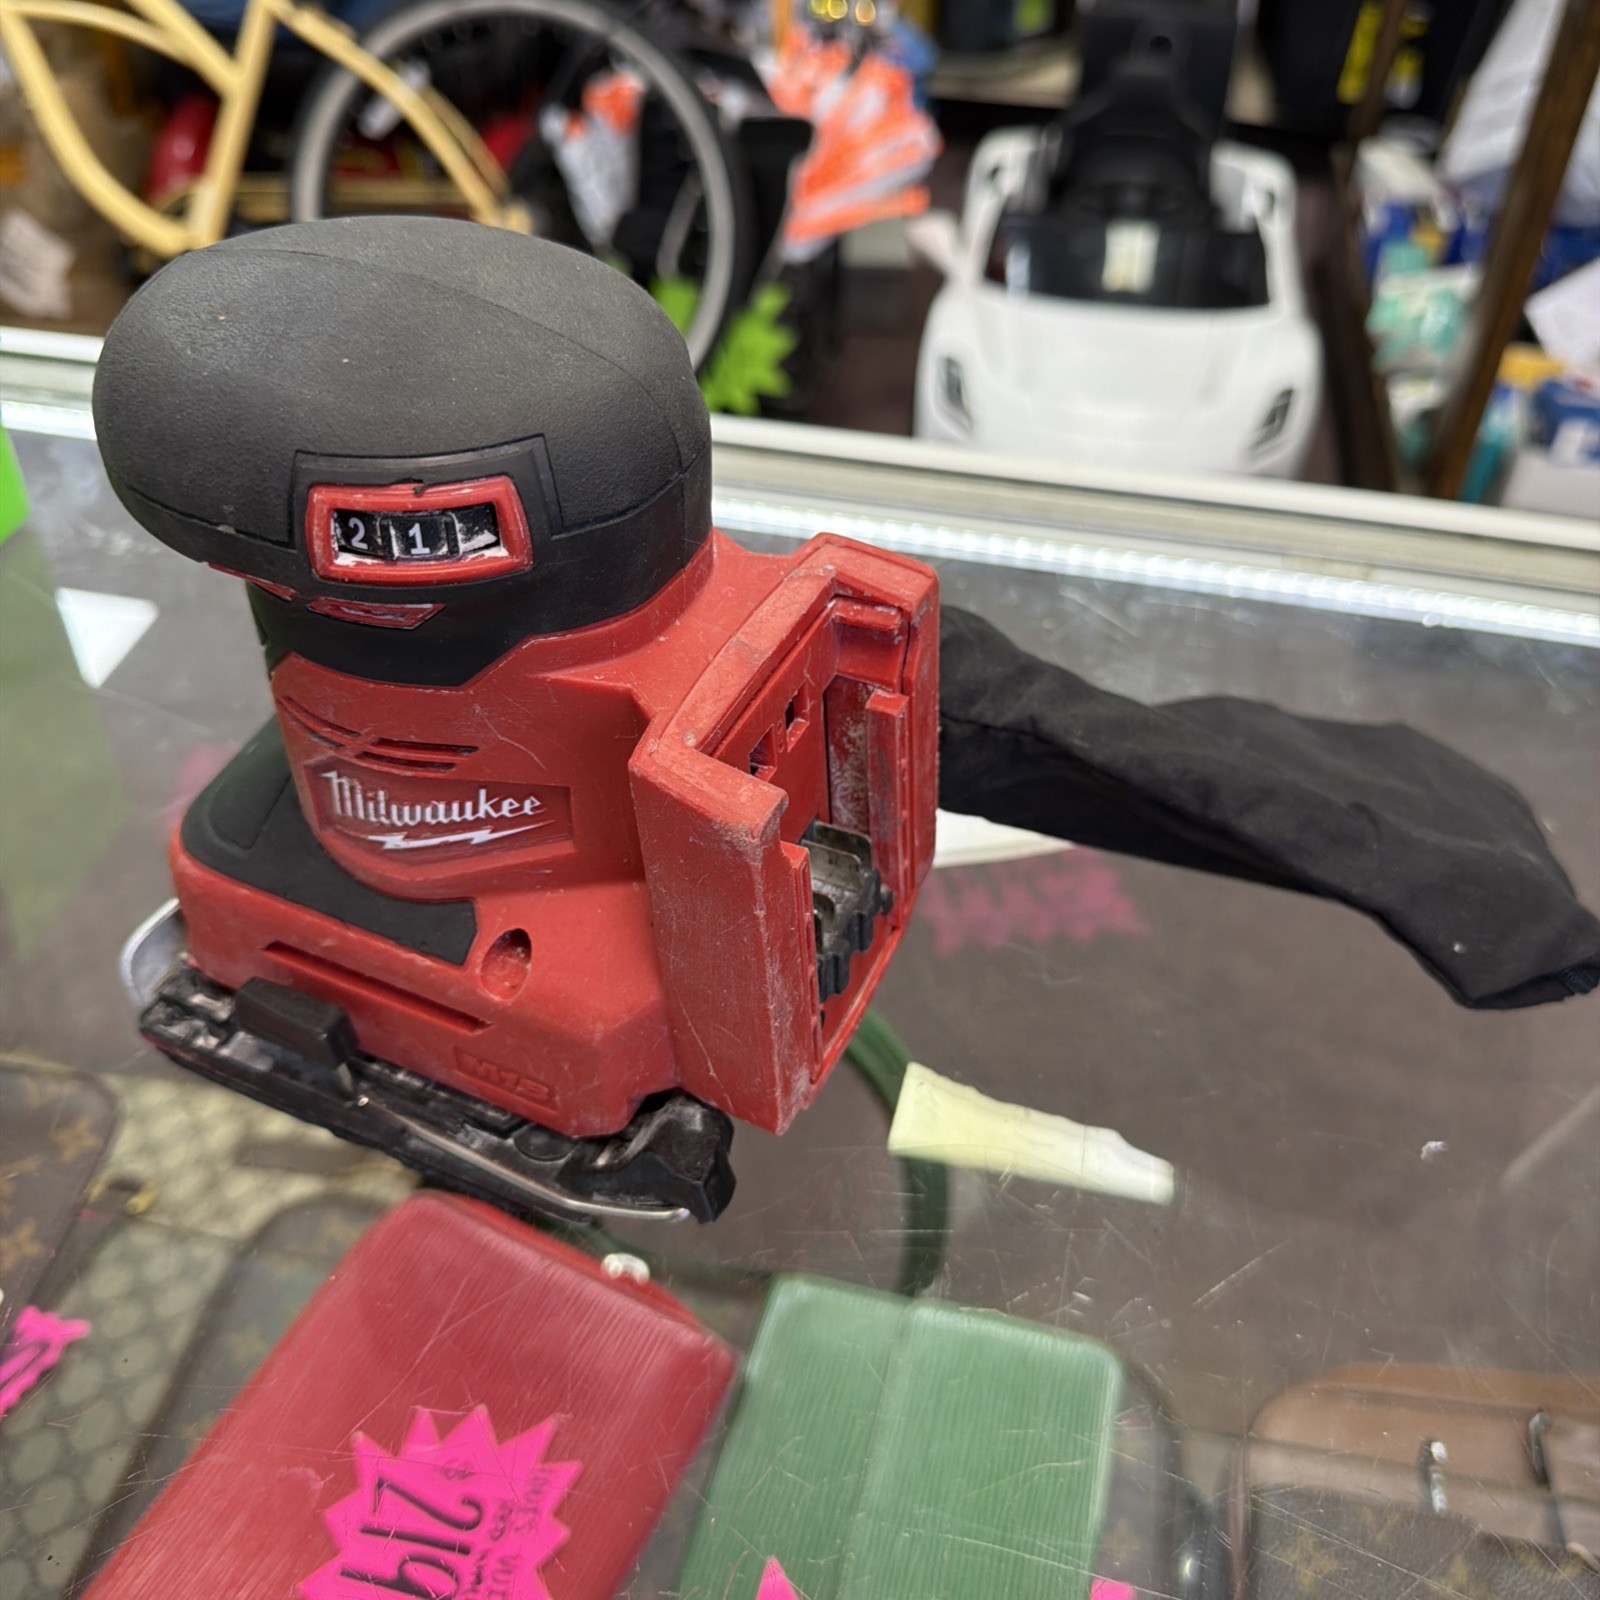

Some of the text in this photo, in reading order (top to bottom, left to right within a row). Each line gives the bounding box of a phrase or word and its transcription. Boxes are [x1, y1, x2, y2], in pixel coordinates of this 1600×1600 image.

[348, 516, 431, 555] 2 1
[320, 770, 546, 827] Milwaukee
